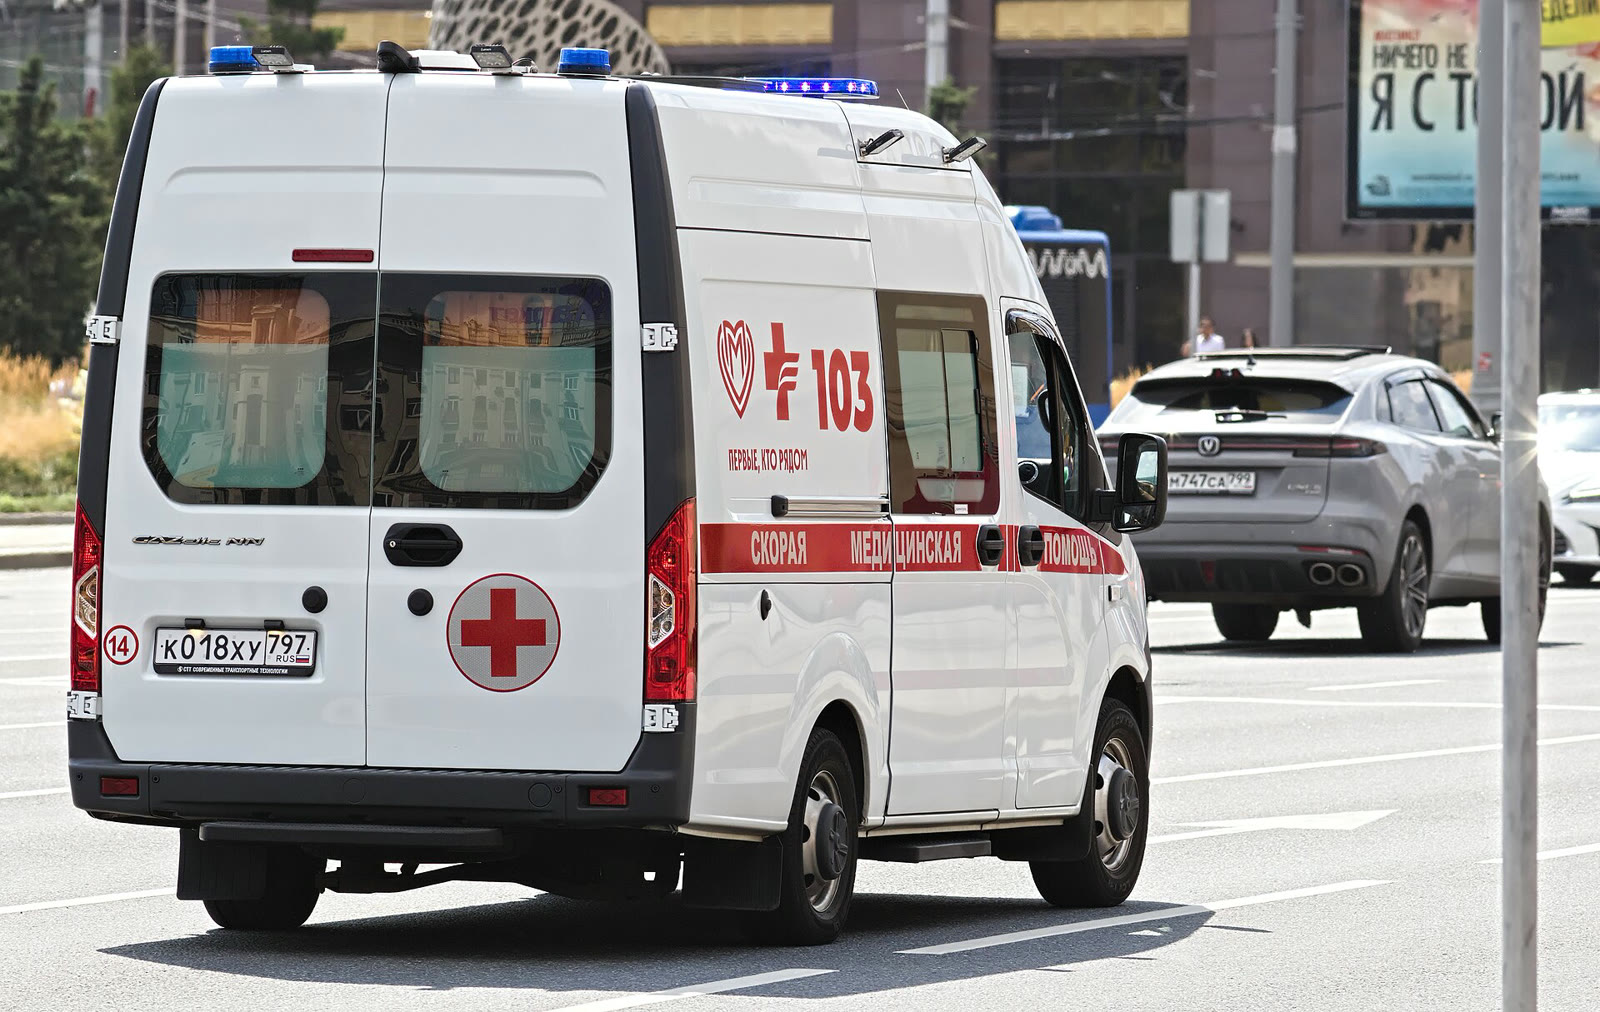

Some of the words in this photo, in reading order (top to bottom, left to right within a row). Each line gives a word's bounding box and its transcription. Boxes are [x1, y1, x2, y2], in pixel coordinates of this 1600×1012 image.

[1372, 43, 1438, 69] НИЧЕГО
[1447, 43, 1469, 69] НЕ
[1371, 72, 1394, 131] Я
[1411, 72, 1436, 131] С
[1447, 71, 1586, 131] ТОЙ
[810, 348, 874, 432] 103
[728, 448, 760, 473] ПЕРВЫЕ,
[761, 448, 778, 471] КТО
[778, 448, 808, 474] РЯДОМ
[1169, 474, 1225, 489] М747СА
[1228, 472, 1251, 484] 799
[226, 537, 266, 546] NN
[751, 530, 807, 566] СКОРАЯ
[850, 530, 962, 571] МЕДИЦИНСКАЯ
[1043, 532, 1098, 573] ПОМОЩЬ
[107, 636, 130, 656] 14
[163, 634, 263, 661] К018ХУ
[268, 634, 307, 655] 797
[275, 654, 295, 663] RUS
